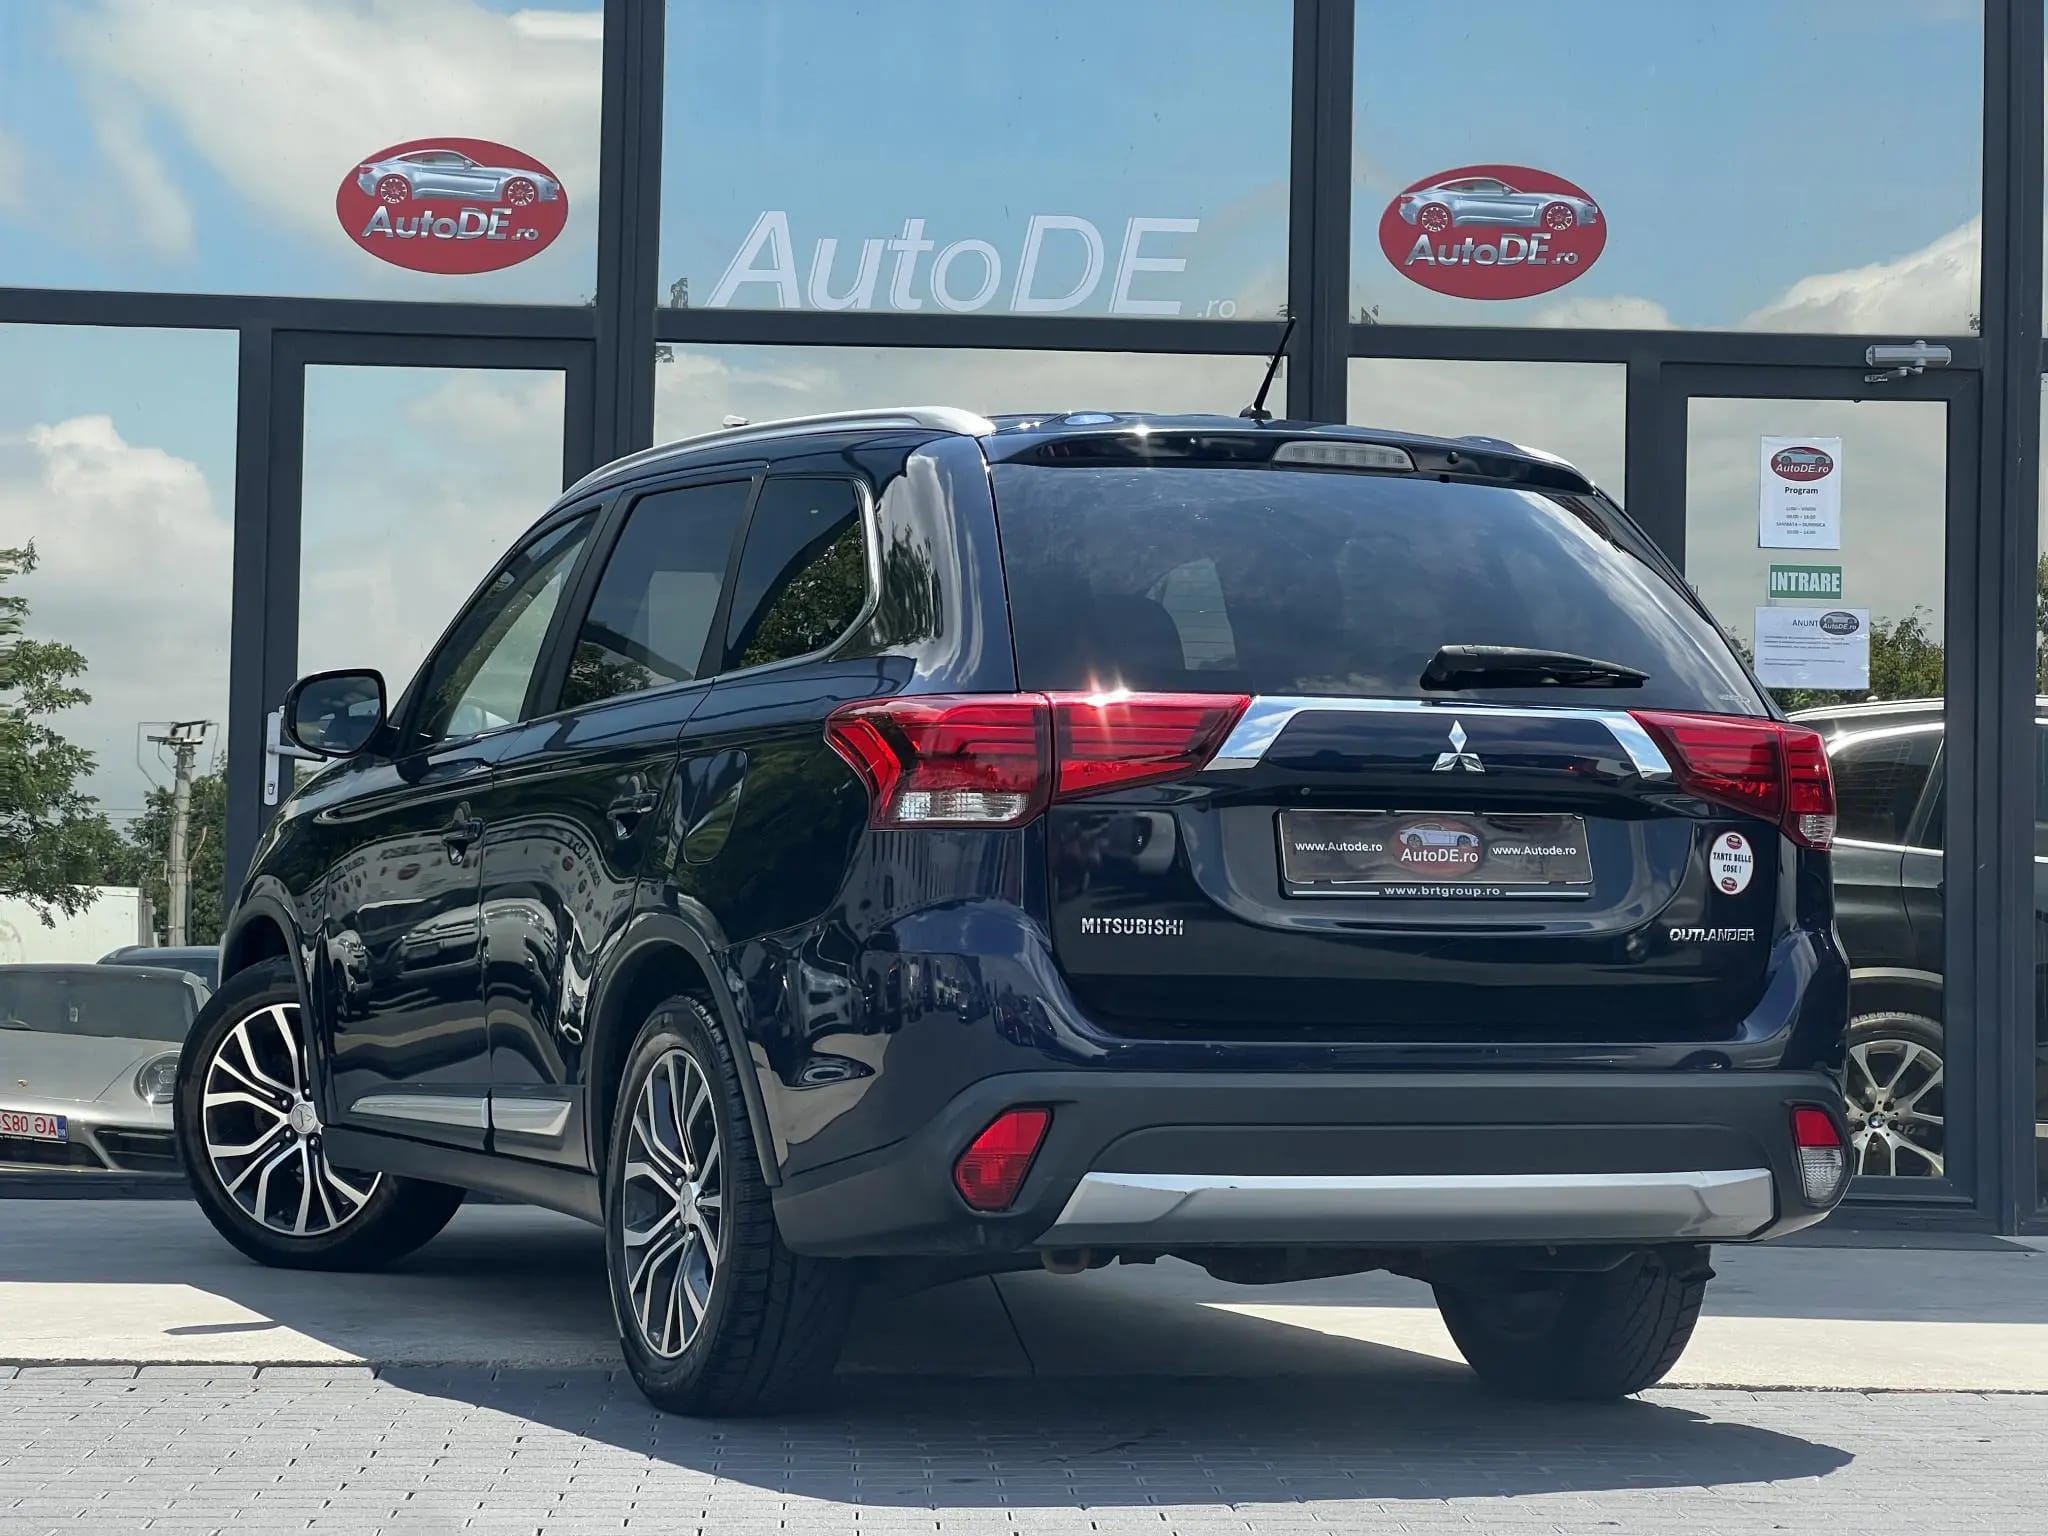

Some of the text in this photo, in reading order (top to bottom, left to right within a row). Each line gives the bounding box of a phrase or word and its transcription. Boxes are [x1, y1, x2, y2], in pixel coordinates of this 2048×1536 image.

[1776, 463, 1829, 473] AutoDE.ro
[1784, 486, 1819, 495] Program
[1771, 571, 1841, 592] INTRARE
[1295, 840, 1383, 852] www.Autode.ro
[1492, 845, 1577, 856] www.Autode.ro
[1401, 848, 1479, 863] AutoDE.ro
[1713, 852, 1752, 863] TANTE BELLE
[1722, 864, 1737, 873] COSE
[1384, 885, 1501, 897] www.brtgroup.ro
[1081, 917, 1184, 935] MITSUBISHI
[1669, 928, 1755, 941] OUTLANDER
